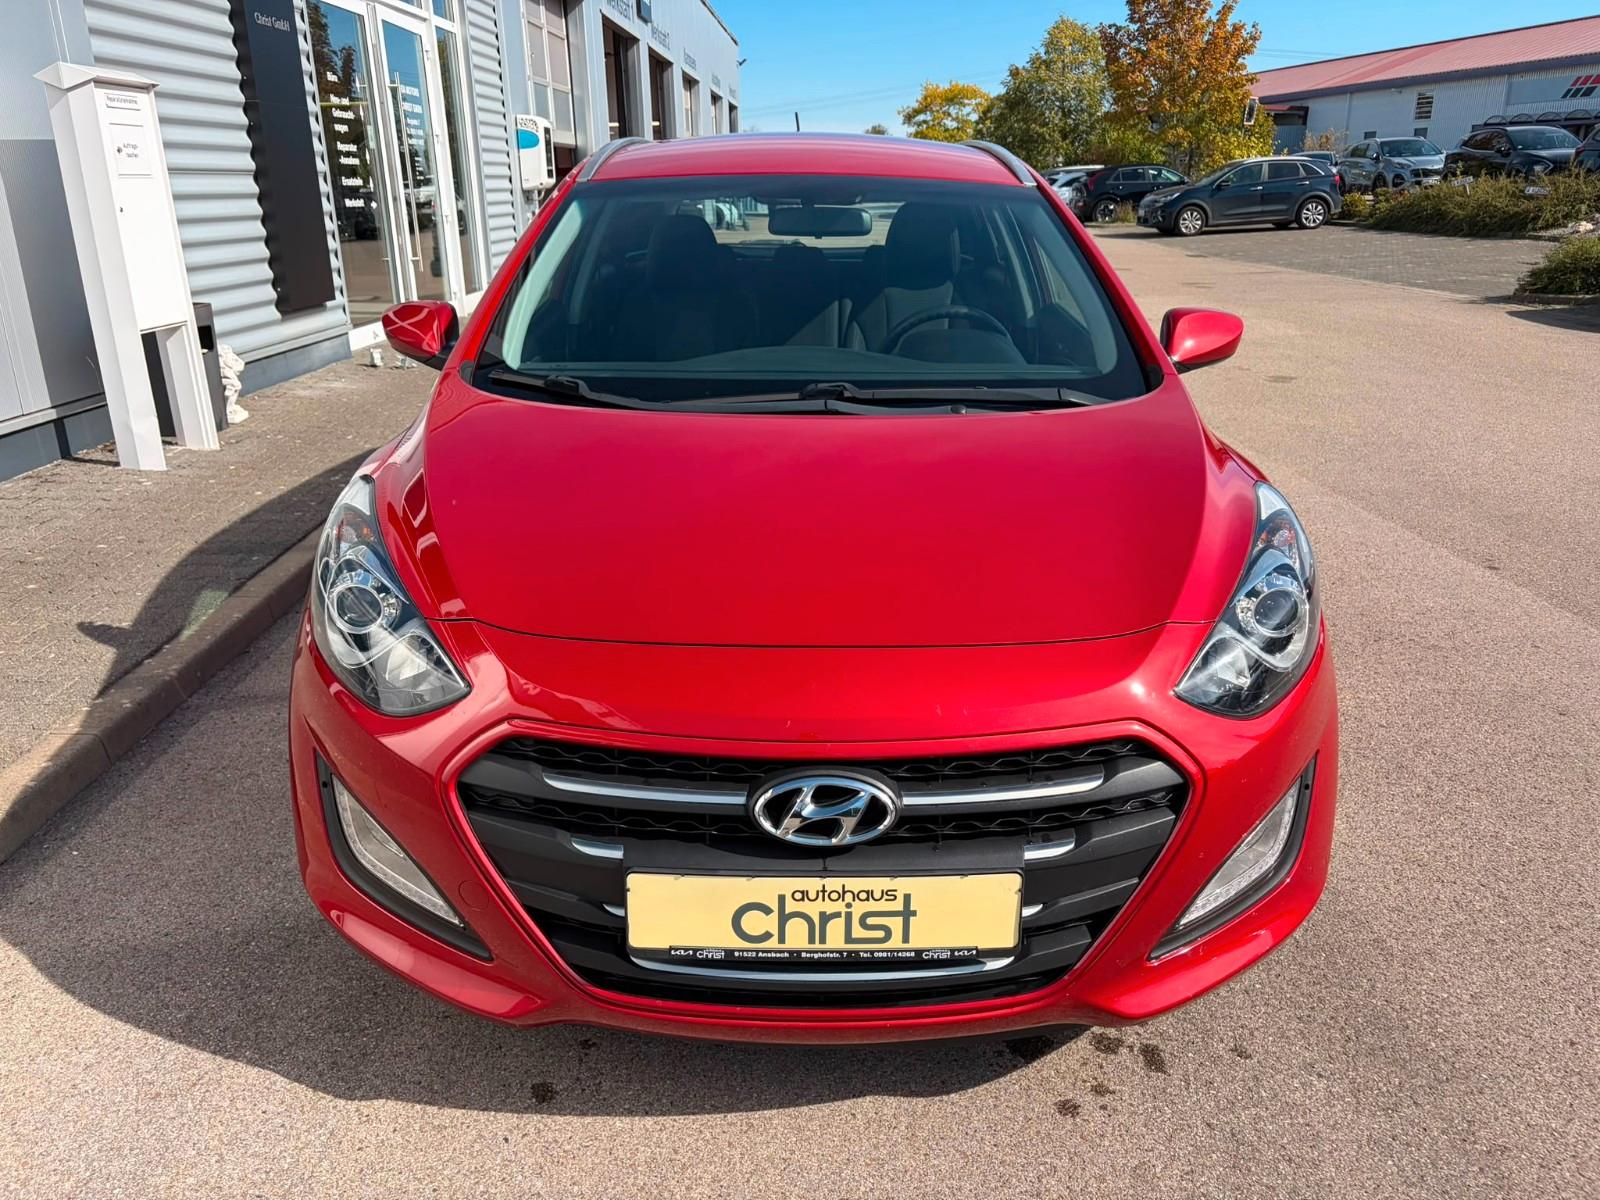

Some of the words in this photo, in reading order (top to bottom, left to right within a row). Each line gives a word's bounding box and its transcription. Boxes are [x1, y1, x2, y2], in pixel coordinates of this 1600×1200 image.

[254, 12, 272, 26] Christ
[334, 124, 349, 134] wagen
[791, 884, 898, 902] autohaus
[801, 951, 841, 959] Berghofstr.
